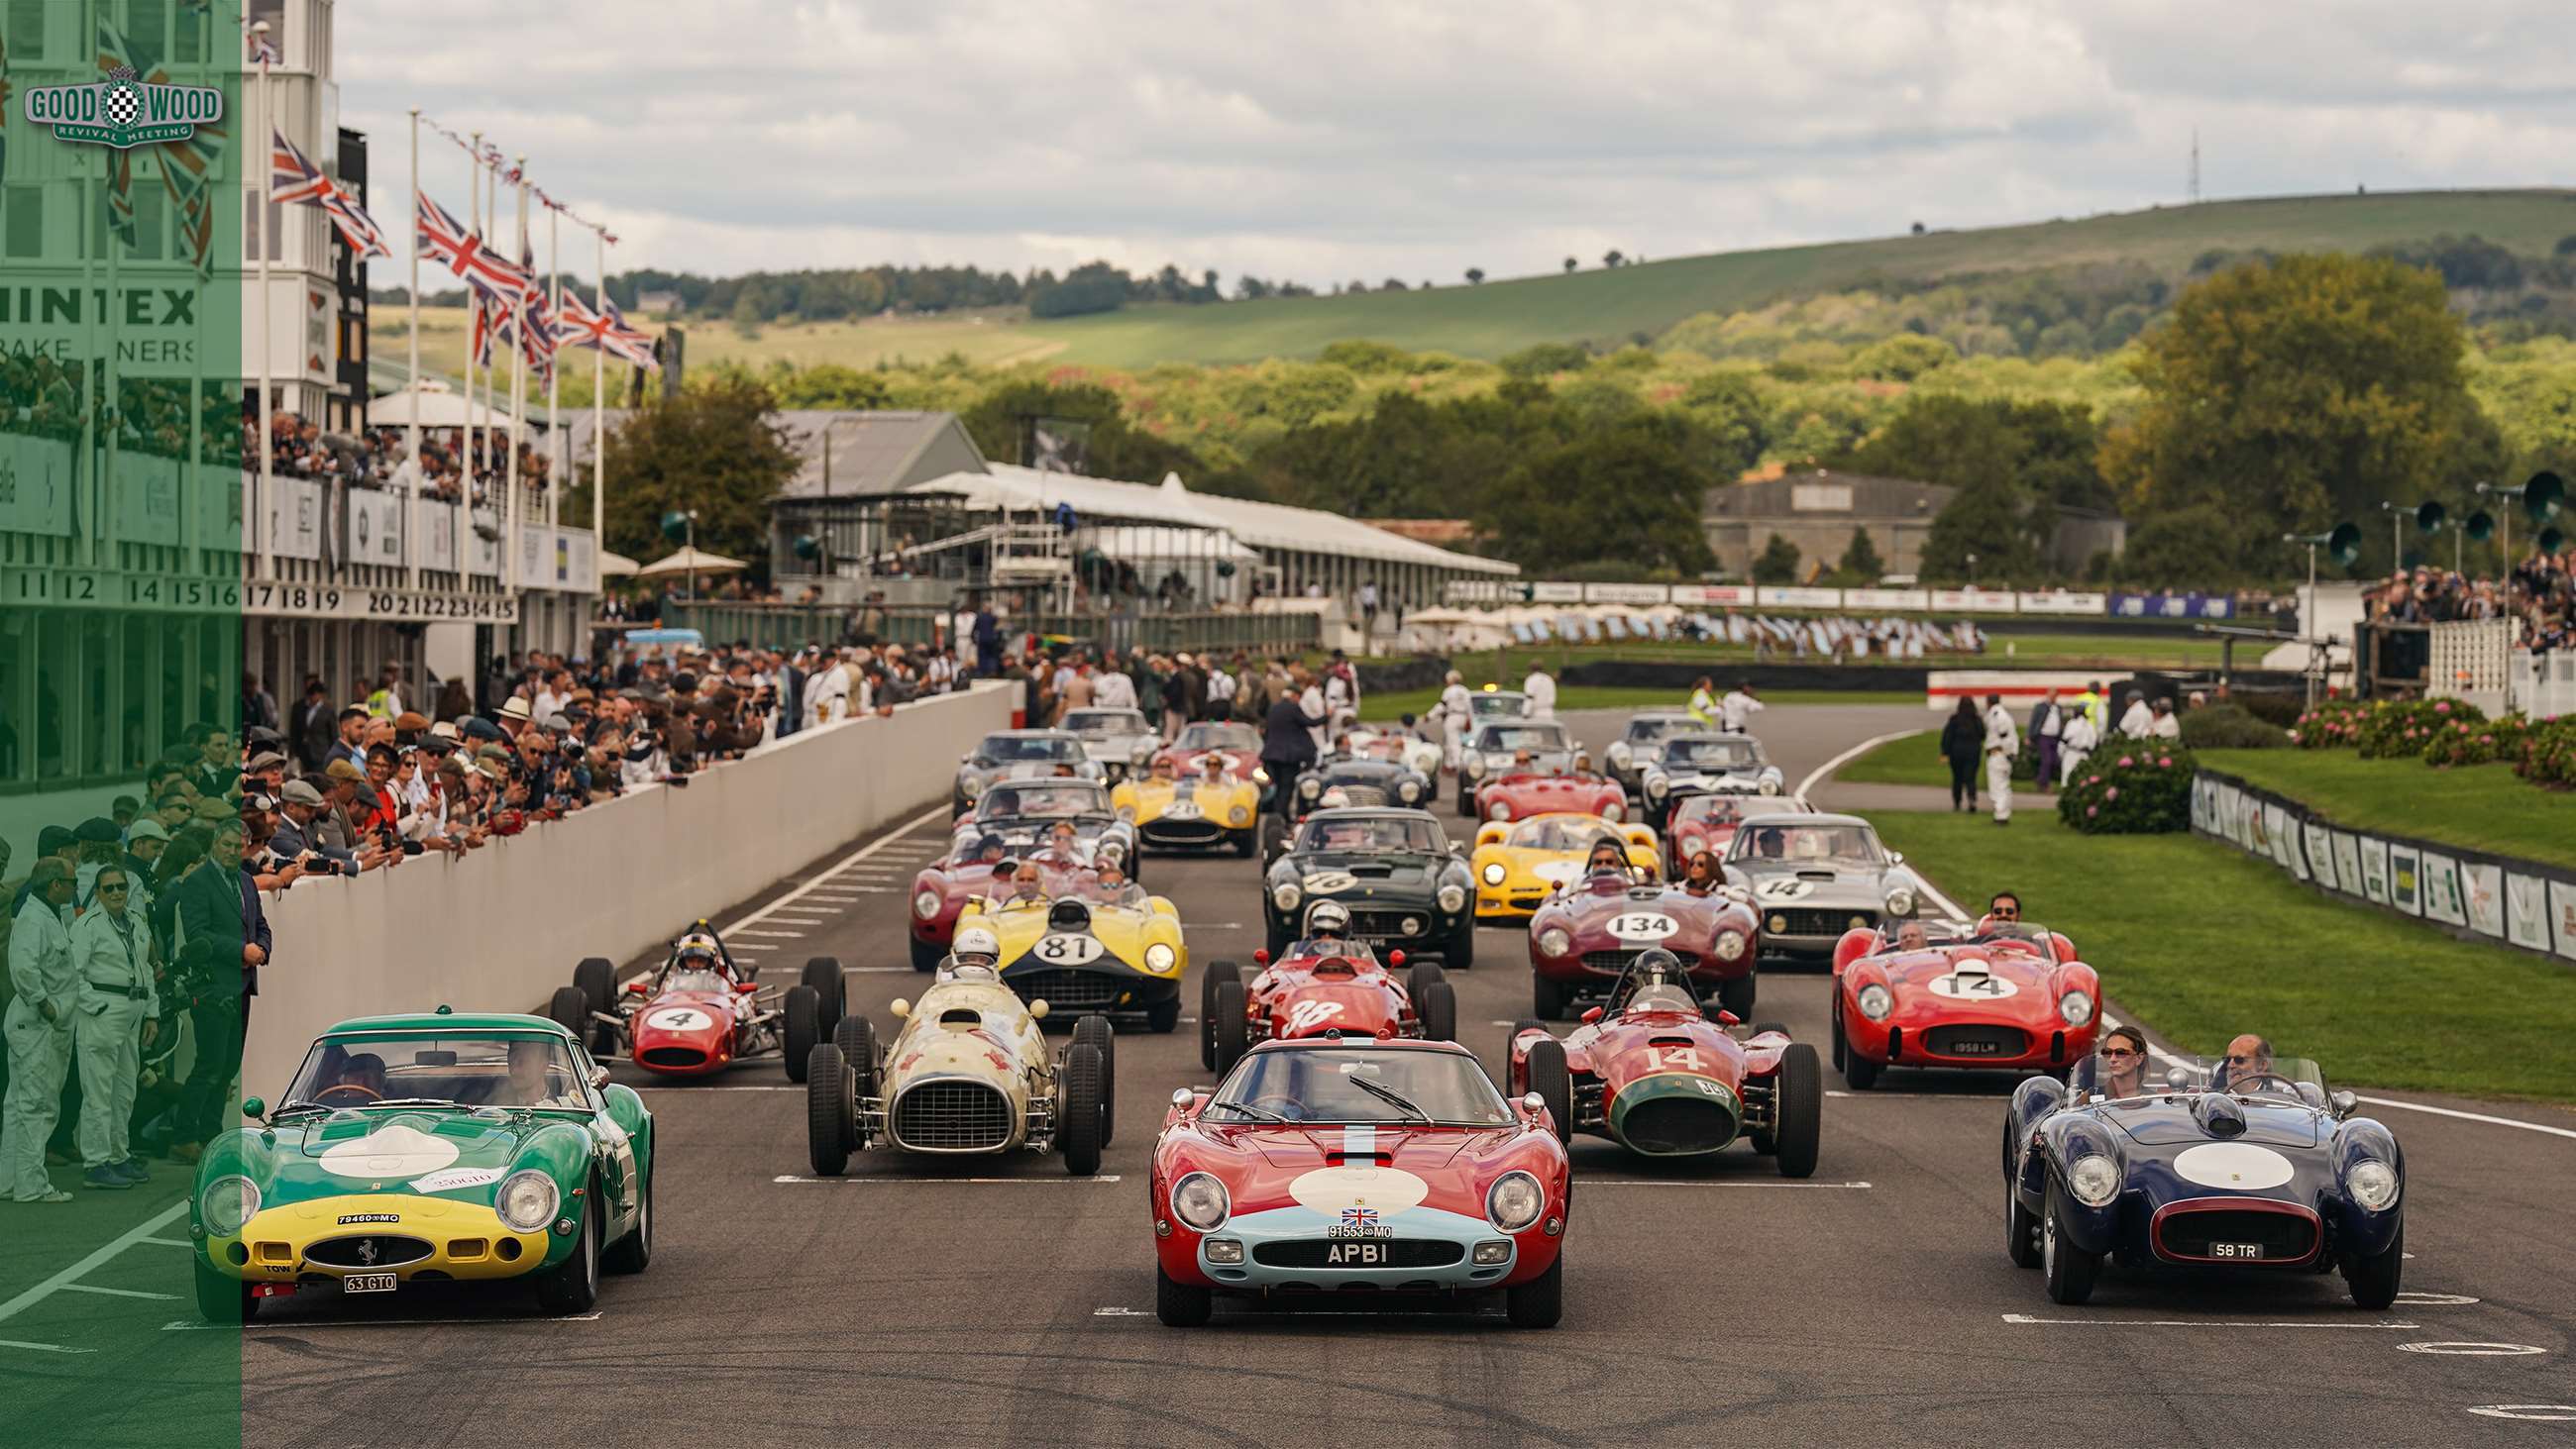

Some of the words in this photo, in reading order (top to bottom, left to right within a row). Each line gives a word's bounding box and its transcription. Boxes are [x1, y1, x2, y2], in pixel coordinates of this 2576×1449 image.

[0, 287, 195, 325] INTEX
[21, 573, 47, 597] 11
[65, 575, 95, 599] 12
[131, 579, 159, 602] 14
[174, 582, 201, 605] 15
[211, 584, 238, 606] 16
[247, 586, 272, 607] 17
[282, 588, 307, 611] 18
[314, 590, 340, 611] 19
[369, 592, 393, 613] 20
[398, 596, 420, 615] 21
[423, 597, 444, 616] 22
[449, 597, 470, 617] 23
[1766, 880, 1802, 895] 14
[1616, 917, 1669, 932] 134
[1044, 937, 1087, 959] 81
[1941, 977, 2005, 995] 14
[666, 1012, 694, 1026] 4
[1281, 999, 1344, 1038] 38
[1644, 1047, 1708, 1071] 14
[2216, 1244, 2234, 1257] 58
[2237, 1244, 2256, 1258] TR
[347, 1278, 364, 1291] 63
[368, 1276, 394, 1290] GTO
